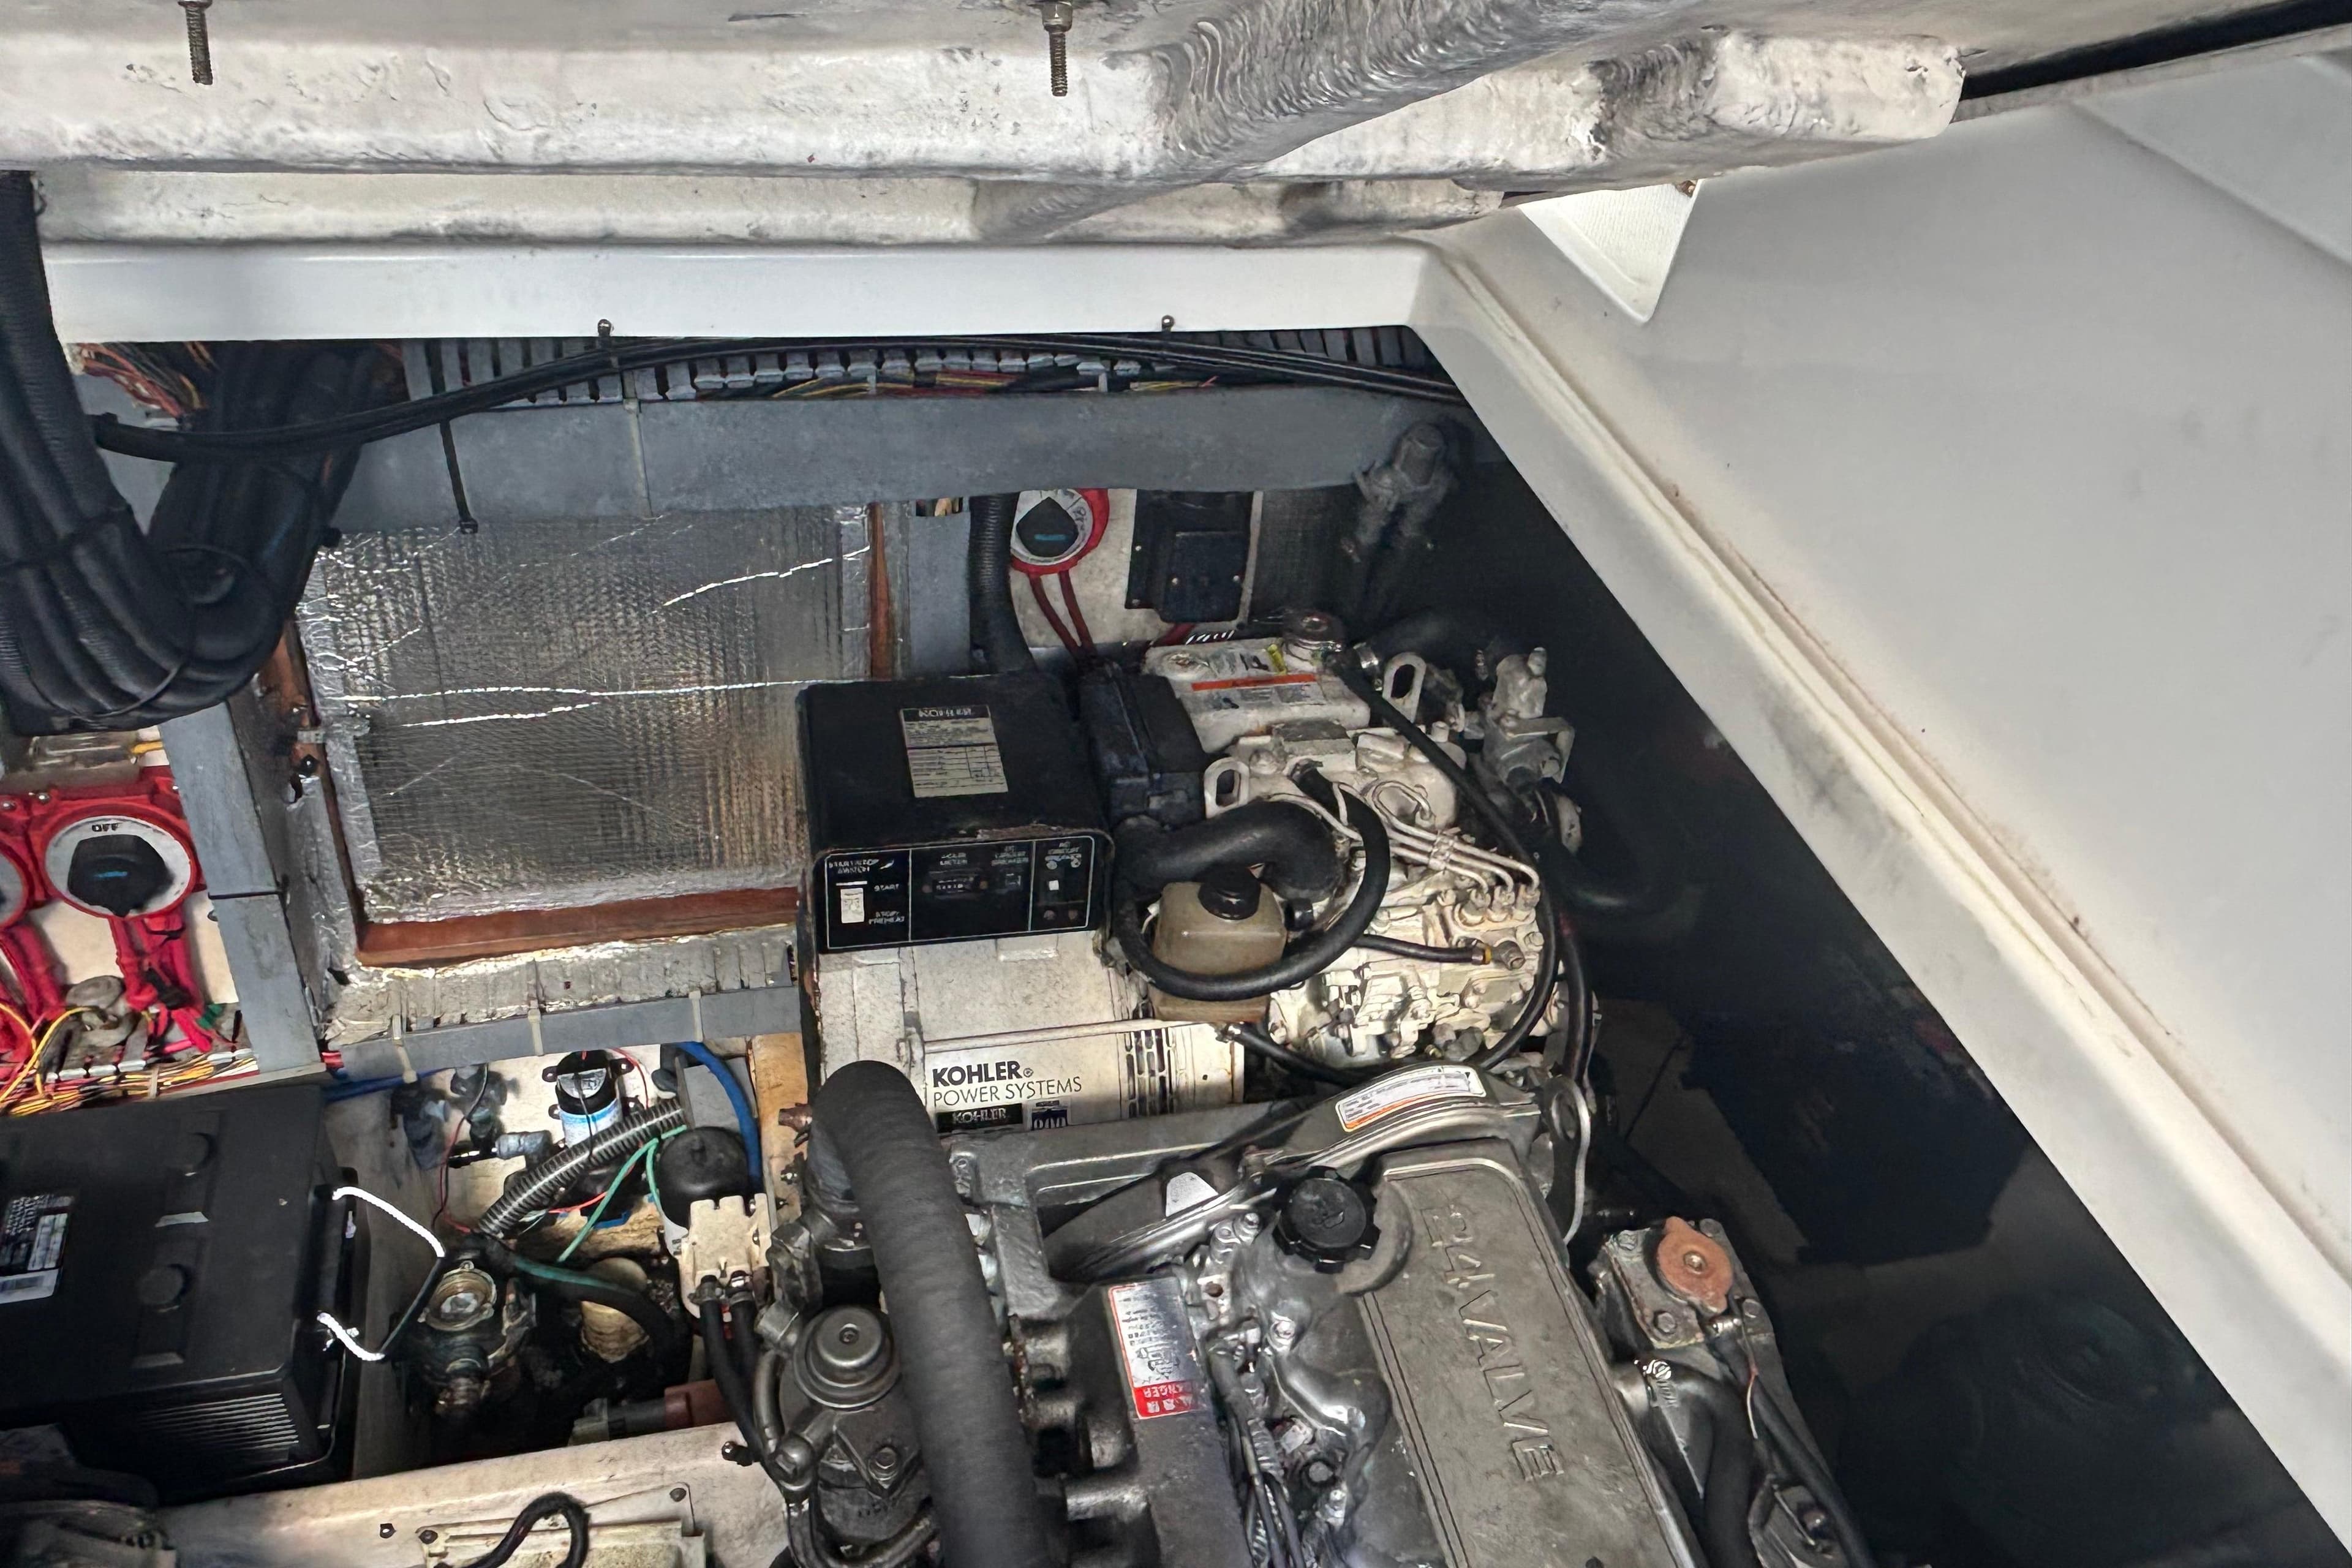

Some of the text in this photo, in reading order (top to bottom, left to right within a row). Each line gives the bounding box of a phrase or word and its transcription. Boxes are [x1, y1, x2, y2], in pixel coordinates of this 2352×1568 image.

[92, 823, 118, 832] OFF
[933, 1076, 1082, 1107] POWER SYSTEMS
[952, 1107, 1007, 1125] KOHLER
[1457, 1289, 1564, 1482] VALVE
